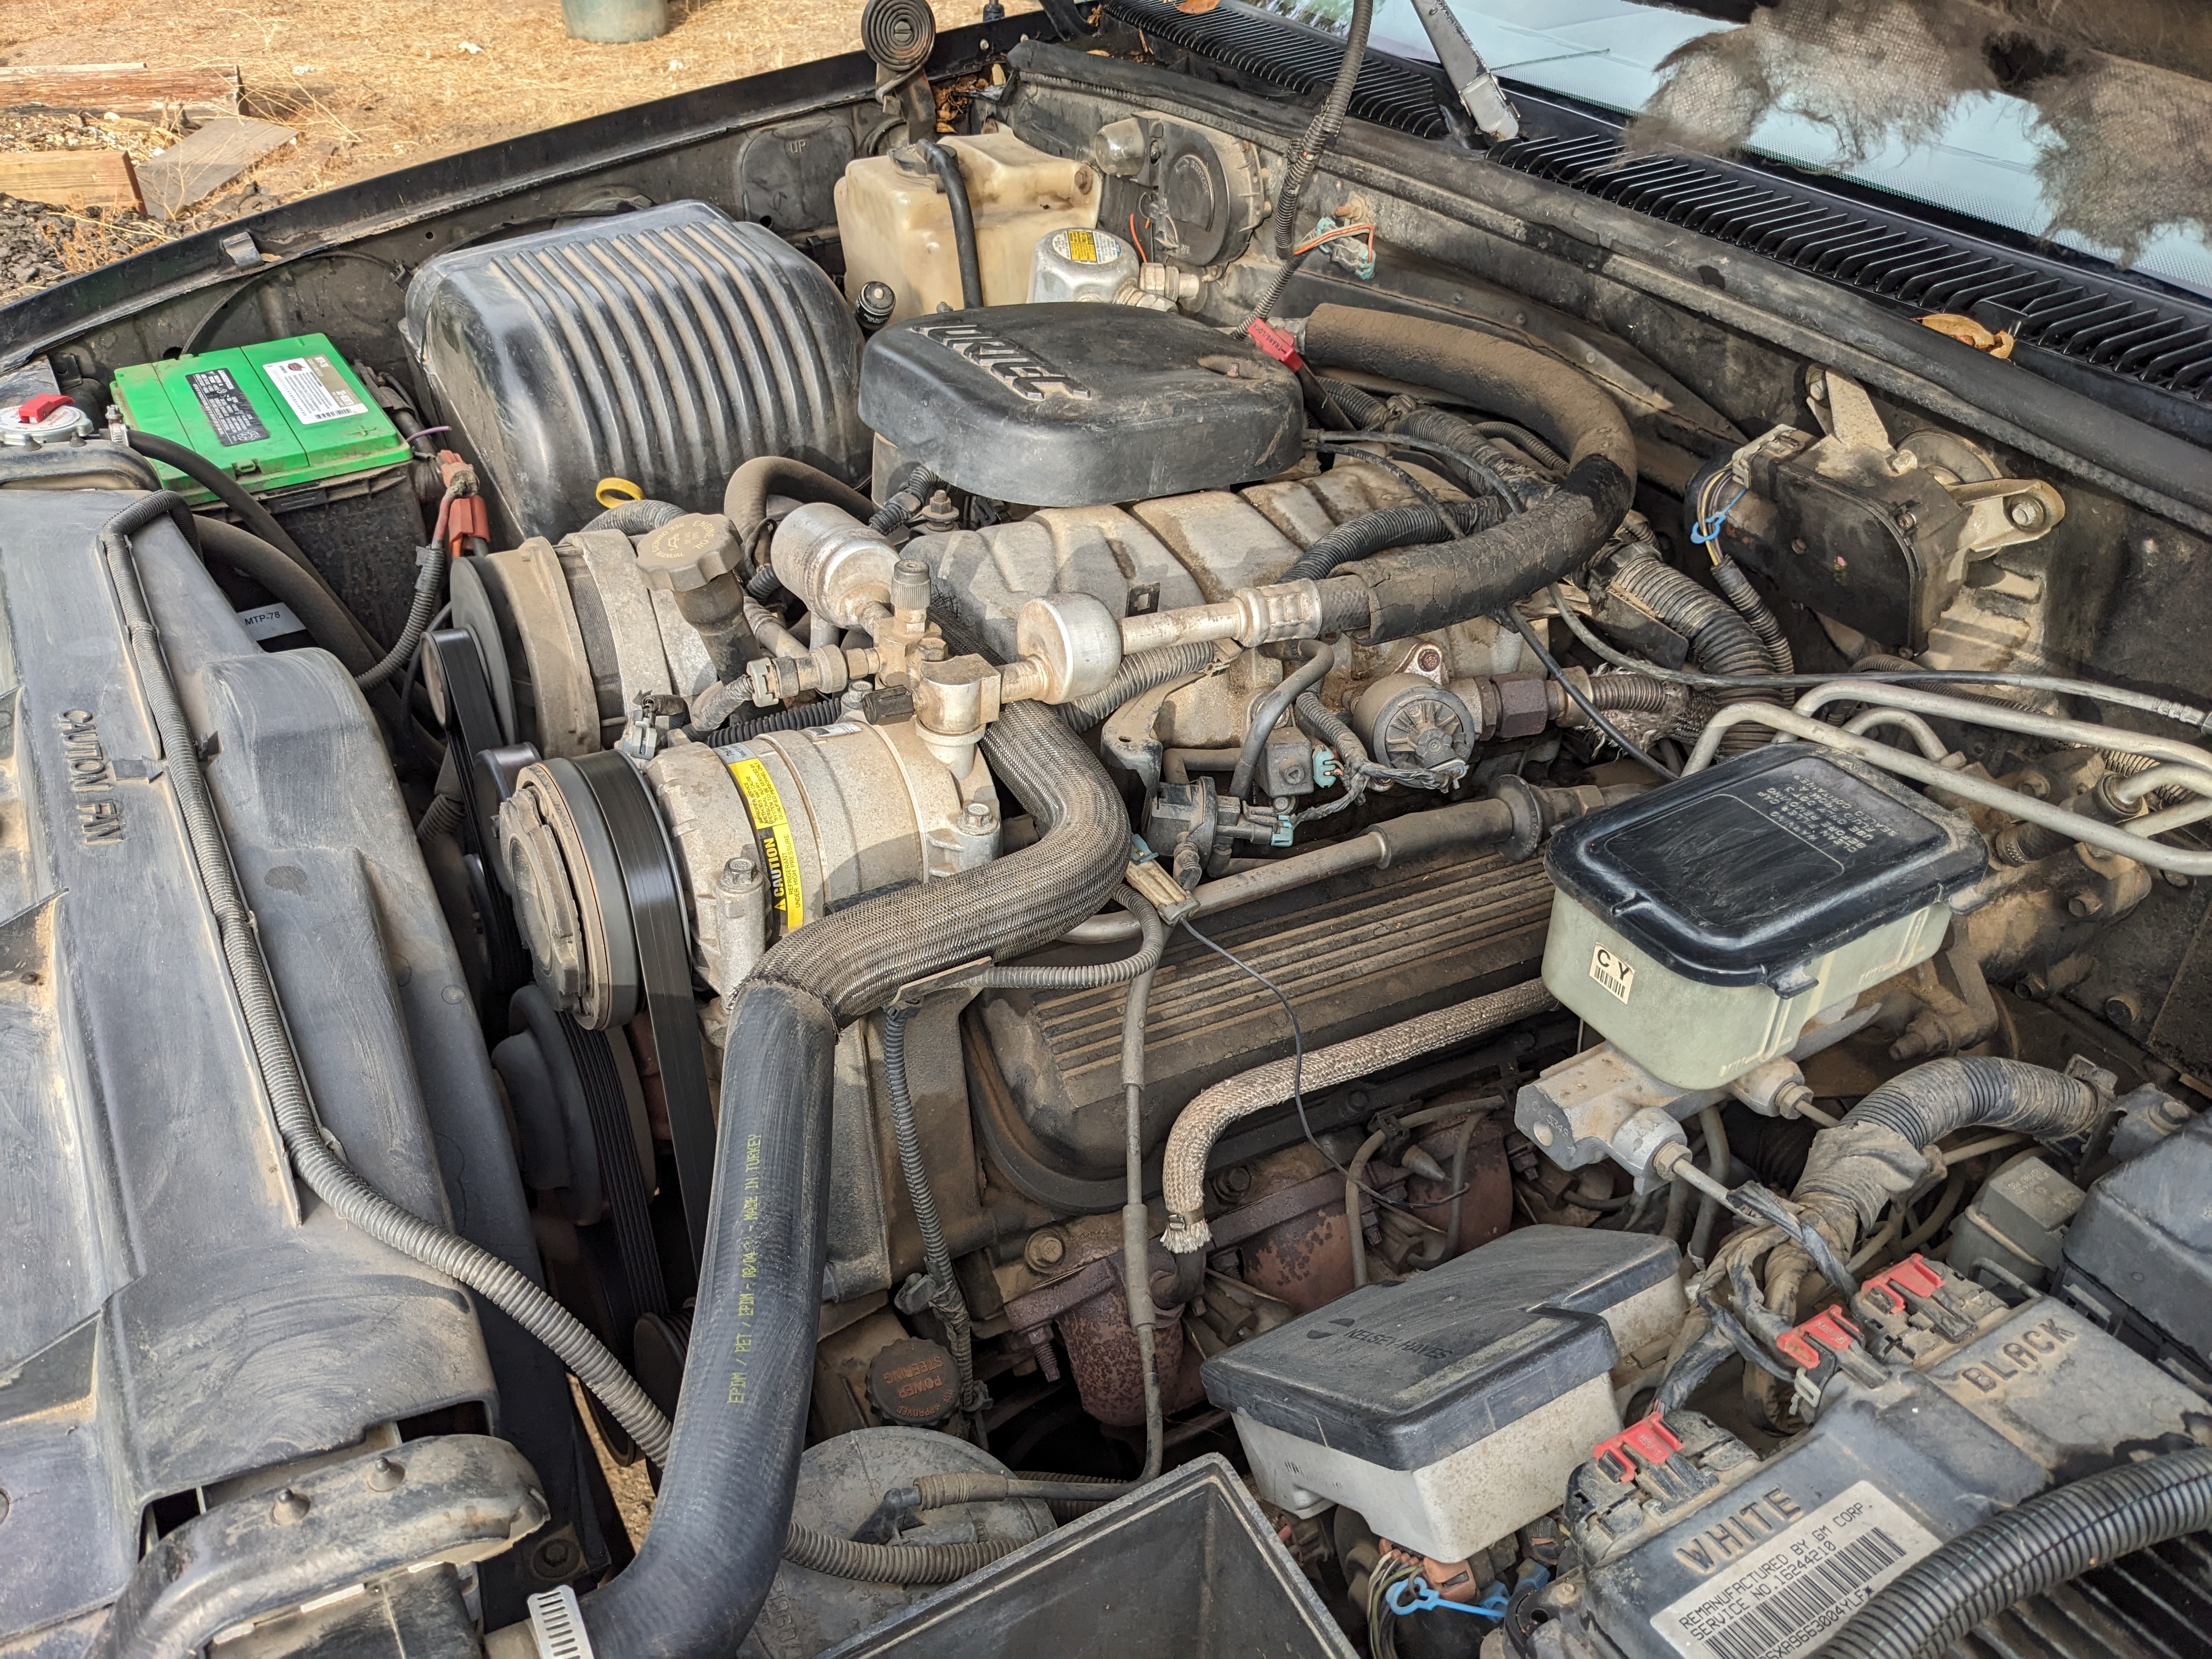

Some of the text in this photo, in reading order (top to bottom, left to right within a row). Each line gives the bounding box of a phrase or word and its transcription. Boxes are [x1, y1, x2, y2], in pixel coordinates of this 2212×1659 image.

[790, 140, 806, 153] UP
[1253, 323, 1283, 352] TRANS/LOCK
[669, 523, 685, 532] SEE
[692, 521, 715, 549] ENGINE OIL
[244, 611, 280, 625] MTP-78
[58, 709, 125, 845] CAUTION FAN
[746, 776, 755, 789] CAUSE
[753, 769, 765, 787] SERVICED
[761, 771, 775, 795] PERSONNEL
[743, 782, 763, 824] IMPROPER SERVICE
[755, 782, 774, 822] PERSONAL INJURY
[758, 799, 768, 824] METHODS
[770, 802, 778, 821] SYSTEM
[771, 795, 783, 820] QUALIFIED
[1791, 792, 1816, 806] DOT
[1792, 774, 1897, 837] SEALED CONTAINER
[1809, 793, 1838, 812] FROM
[1757, 791, 1858, 852] CLEAN FILLER CAP
[1766, 787, 1866, 849] BEFORE REMOVING
[1769, 810, 1818, 842] WARNING
[1816, 808, 1847, 825] ONLY
[1844, 812, 1876, 832] FLUID
[1848, 825, 1874, 841] USE
[783, 834, 795, 868] PRESSURE
[763, 837, 785, 898] CAUTION
[782, 853, 793, 895] REFRIGERANT
[746, 1133, 761, 1173] TURKEY
[744, 1176, 760, 1190] IN
[743, 1195, 759, 1221] MADE
[738, 1293, 755, 1316] EPDM
[735, 1333, 752, 1352] PET
[1344, 1328, 1453, 1359] KELSEY-HAYES
[1962, 1318, 2075, 1393] BLACK
[883, 1356, 944, 1385] STEERING
[727, 1372, 747, 1403] EPDM
[897, 1374, 943, 1399] POWER
[896, 1403, 940, 1417] APPROVED
[1677, 1486, 1802, 1571] WHITE
[1679, 1554, 1789, 1629] REMANUFACTURED
[1790, 1538, 1809, 1556] BY
[1812, 1526, 1833, 1542] GM
[1690, 1541, 1837, 1641] SERVICE NO.16244210
